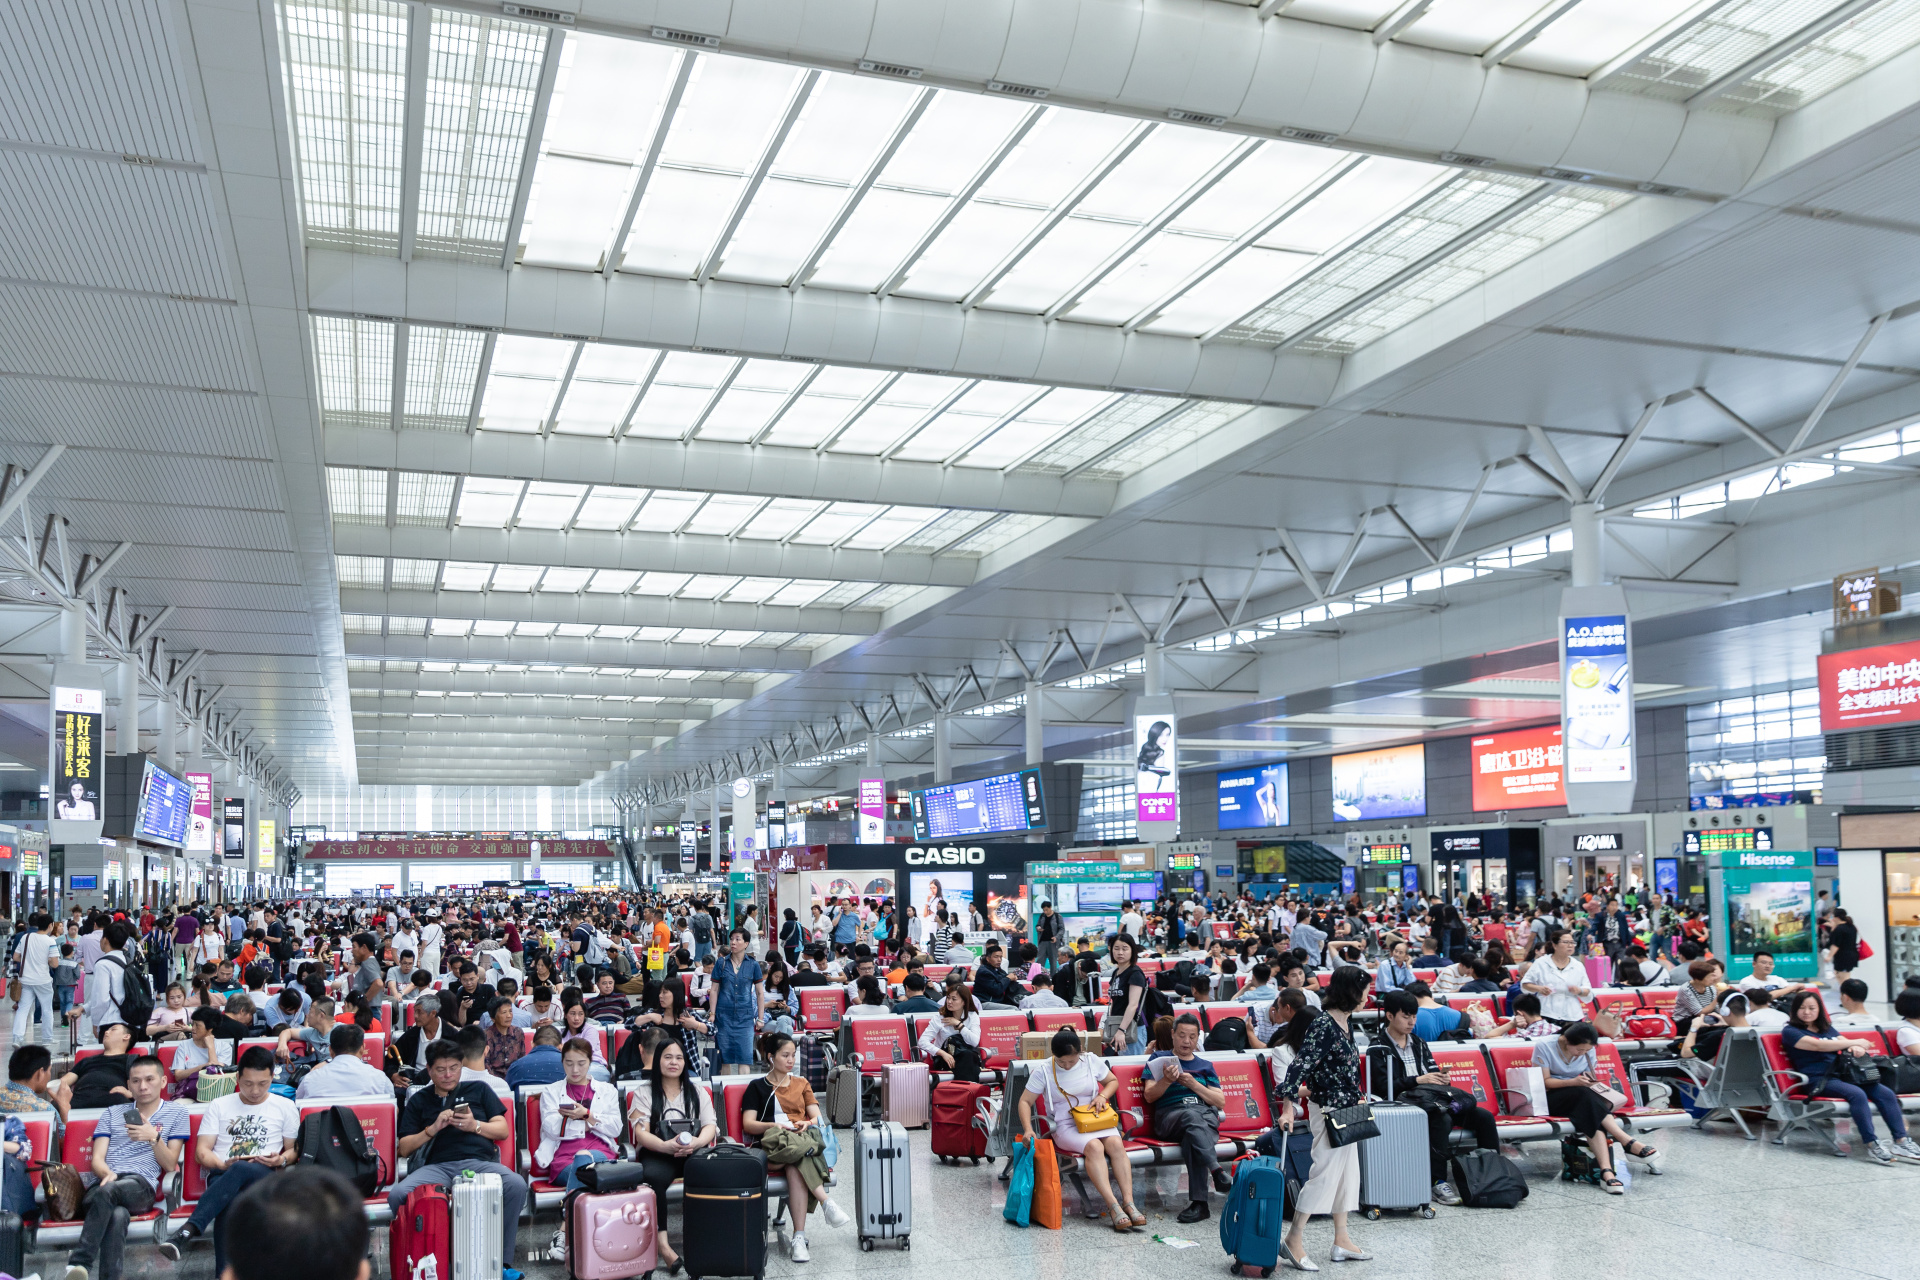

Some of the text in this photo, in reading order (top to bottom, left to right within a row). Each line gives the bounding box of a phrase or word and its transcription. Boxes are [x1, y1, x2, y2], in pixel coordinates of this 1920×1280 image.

[1837, 658, 1920, 693] 美的中央
[1838, 686, 1920, 711] 全变频科技
[76, 714, 91, 778] 好莱客
[1141, 797, 1172, 806] CONFU
[323, 843, 388, 855] 不忘初心
[396, 843, 460, 855] 牢记使命
[469, 842, 529, 855] 交通强国
[1576, 834, 1618, 851] HONMA
[905, 847, 986, 865] CASIO
[1739, 853, 1795, 866] Hisense
[1034, 864, 1086, 875] Hisense
[599, 1259, 648, 1275] HELLO KITTY
